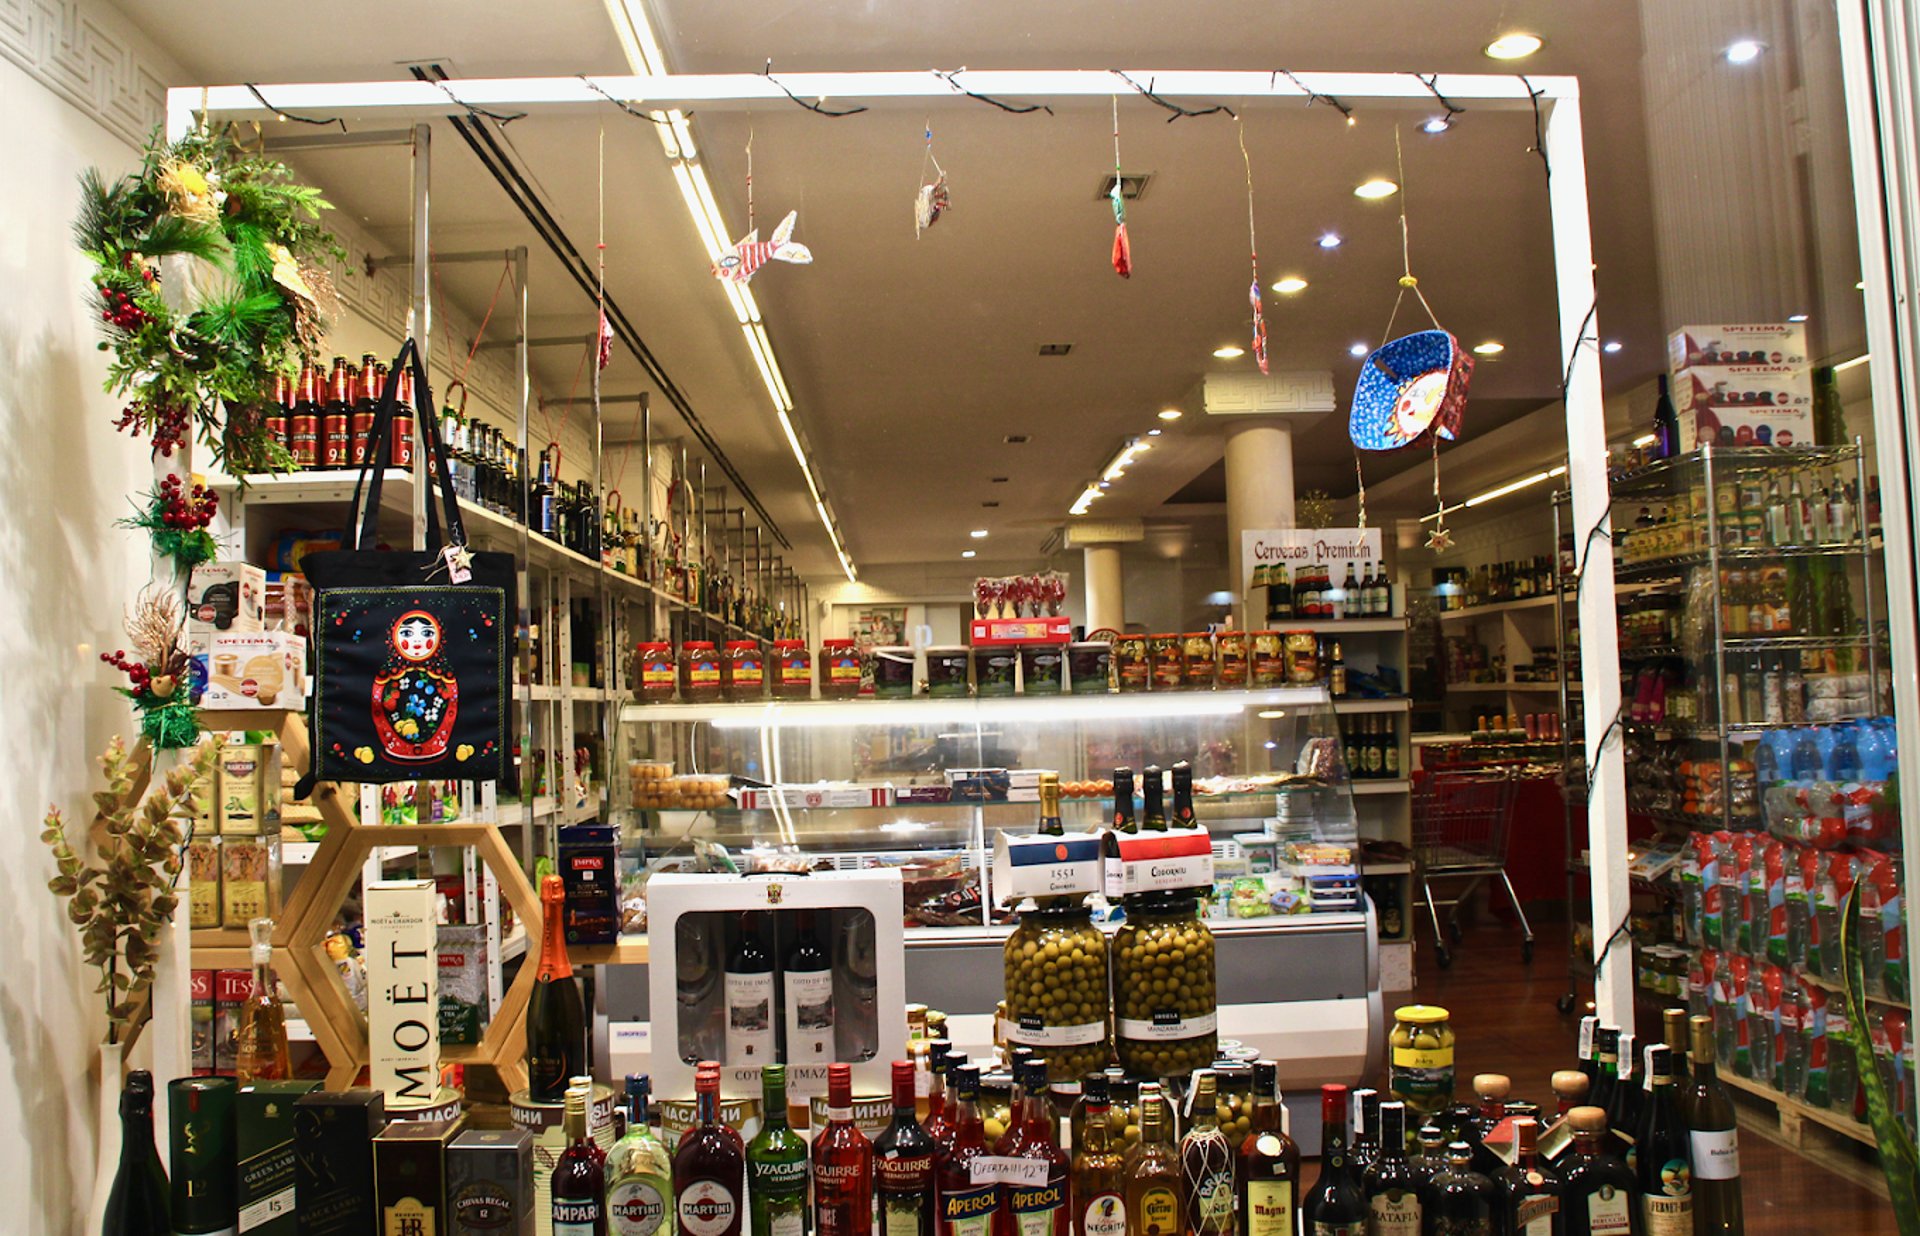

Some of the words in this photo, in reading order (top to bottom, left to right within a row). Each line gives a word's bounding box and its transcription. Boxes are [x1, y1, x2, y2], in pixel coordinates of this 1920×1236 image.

[328, 448, 337, 461] 9
[356, 447, 365, 460] 9
[402, 449, 410, 462] 9
[429, 460, 436, 474] 9
[1254, 540, 1309, 560] Cervezas
[573, 857, 602, 867] IMPRA
[1051, 868, 1074, 879] 1551
[438, 955, 463, 966] MPRA
[191, 975, 208, 994] SS
[222, 976, 257, 995] TESS
[386, 940, 432, 1101] MOËT
[1147, 1024, 1188, 1033] MANZANILLA
[794, 1068, 827, 1080] IMAZ
[242, 1163, 273, 1183] GREEN
[456, 1197, 485, 1209] CHIVAS
[485, 1197, 511, 1209] REGAL
[946, 1191, 998, 1215] APEROL
[1011, 1188, 1061, 1209] APEROL
[267, 1200, 282, 1212] 15
[614, 1203, 660, 1216] MARTINI
[684, 1203, 731, 1216] MARTINI
[1254, 1204, 1286, 1218] Magno
[1087, 1221, 1126, 1233] NEGRITA
